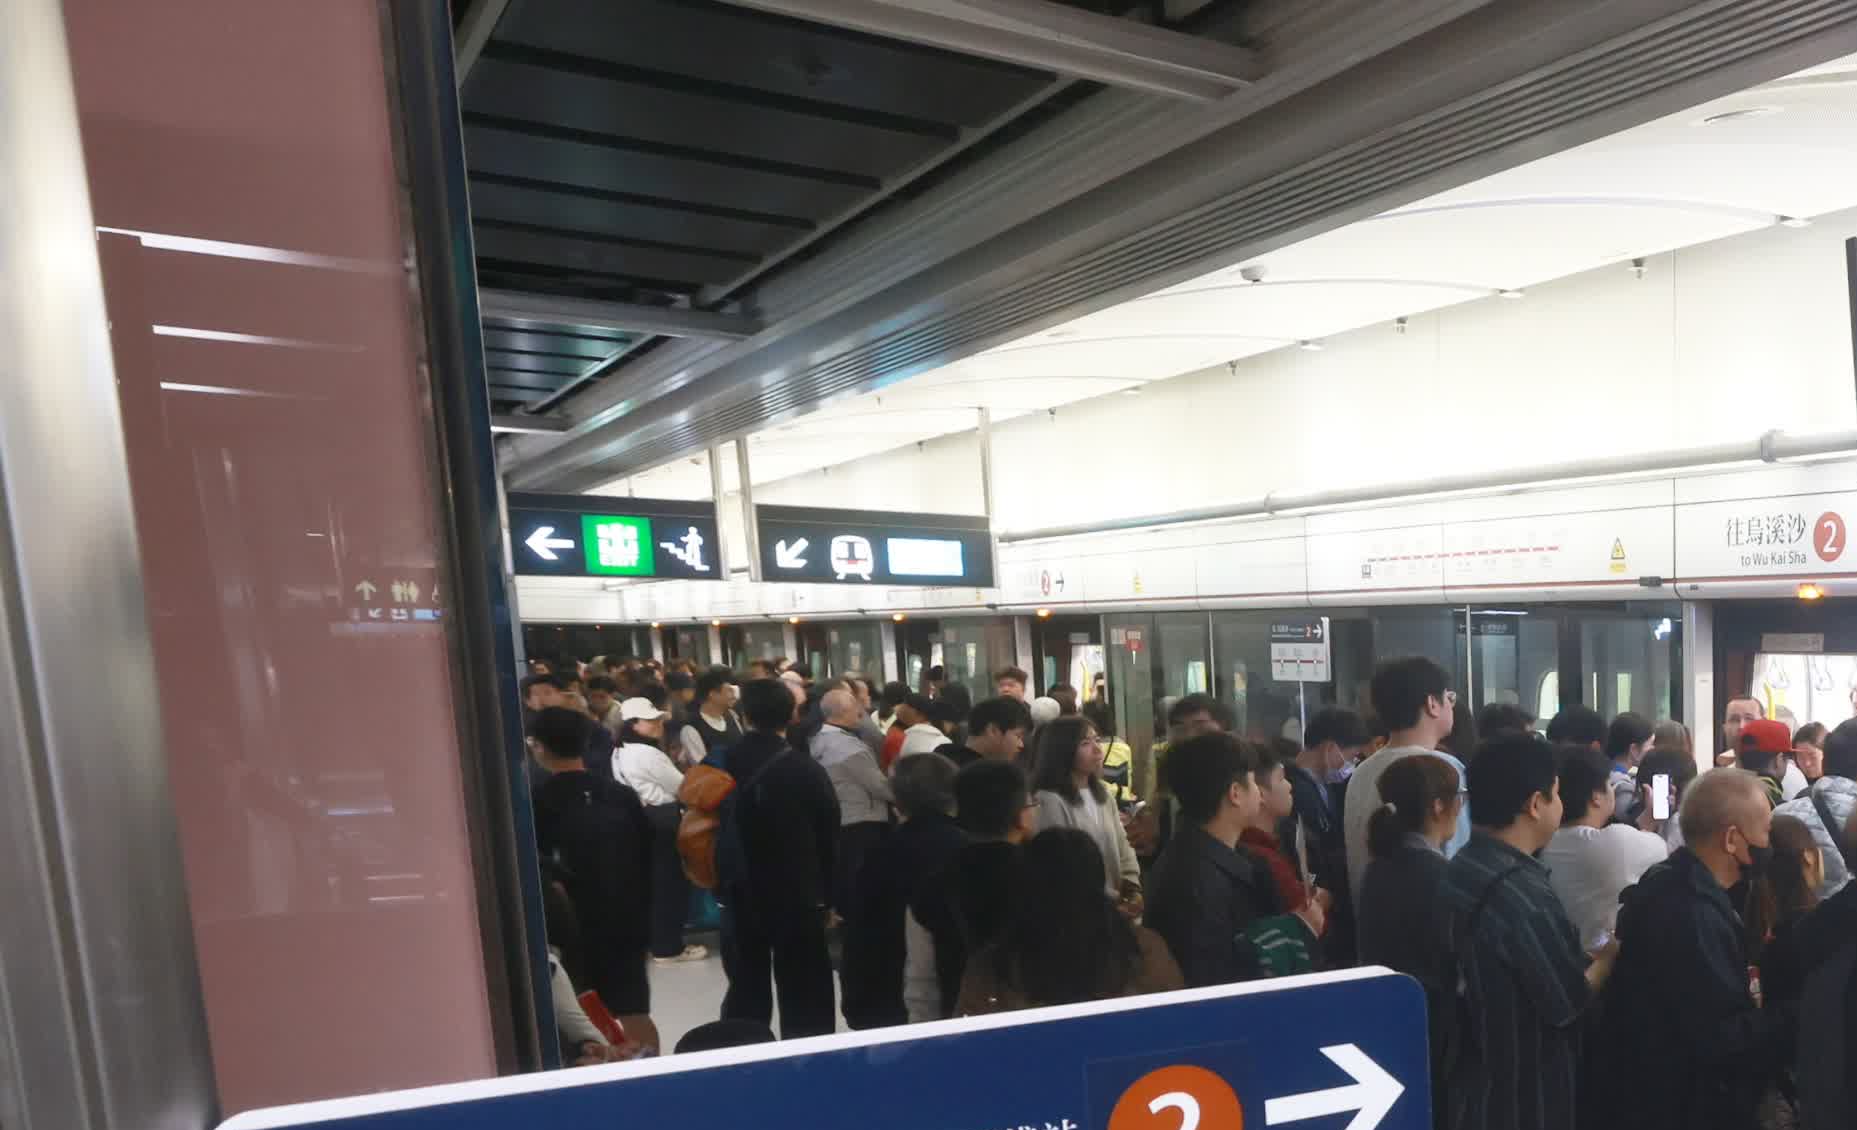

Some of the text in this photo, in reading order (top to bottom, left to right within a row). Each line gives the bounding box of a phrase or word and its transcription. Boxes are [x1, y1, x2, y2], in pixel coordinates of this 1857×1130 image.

[1726, 513, 1807, 548] 往烏溪沙
[1823, 520, 1837, 552] 2
[1741, 550, 1807, 567] to Wu Kai Sha
